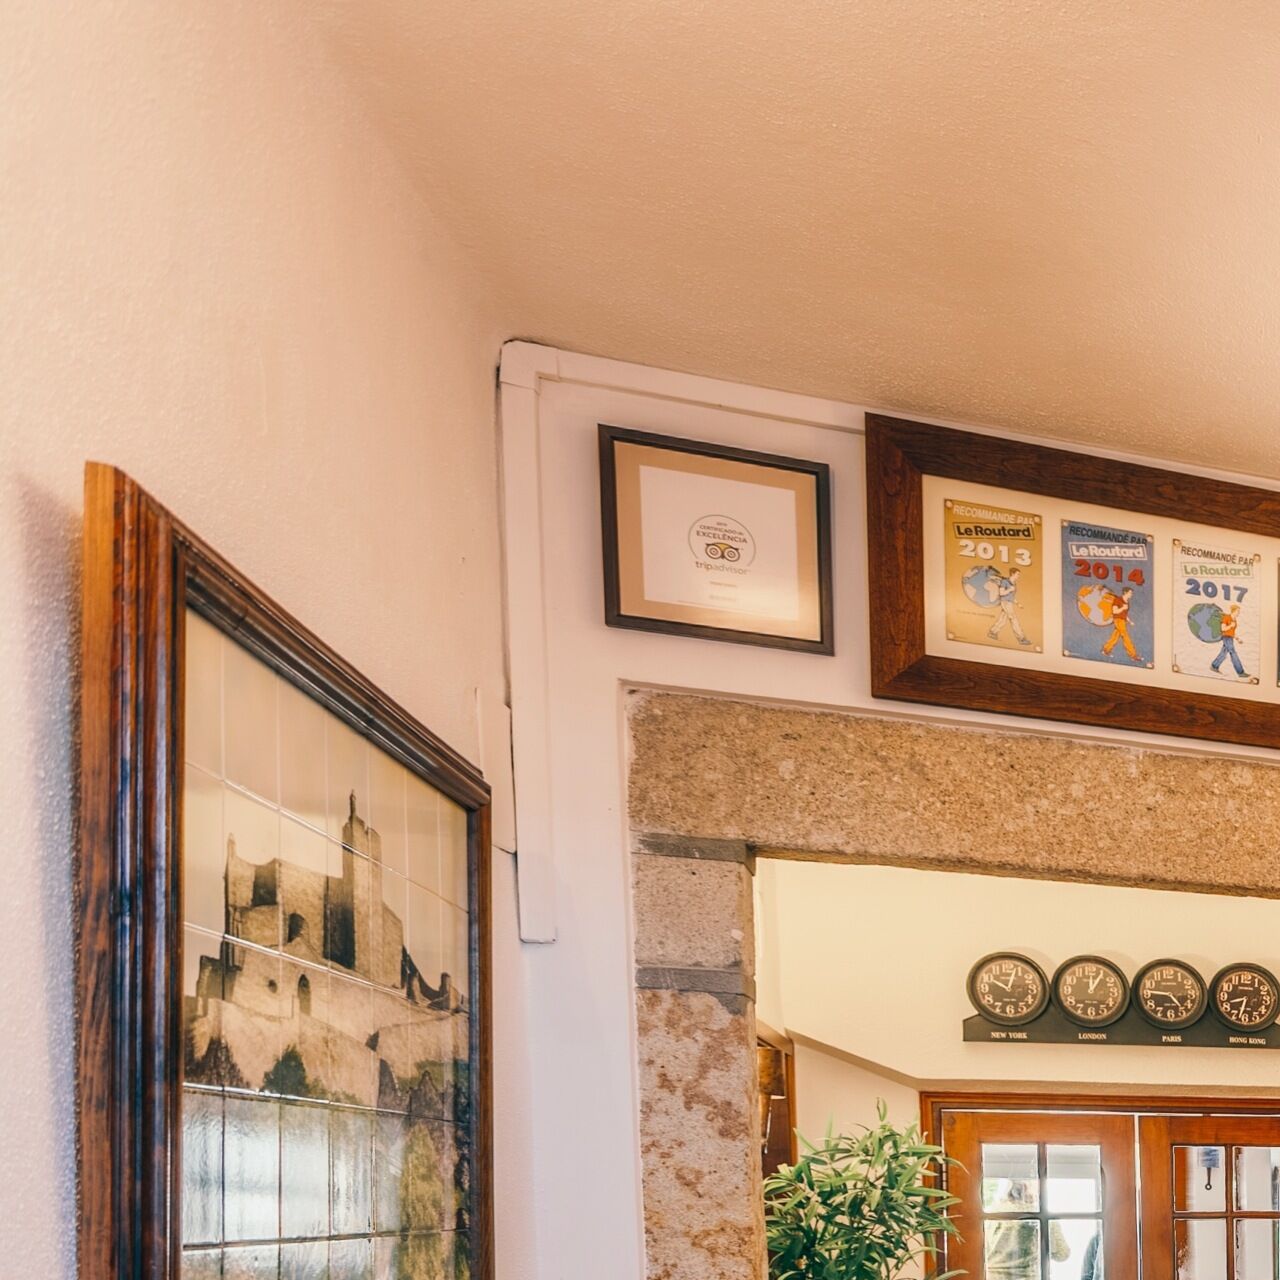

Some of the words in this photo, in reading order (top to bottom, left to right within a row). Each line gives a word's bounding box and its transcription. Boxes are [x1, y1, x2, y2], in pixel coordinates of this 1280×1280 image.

[956, 525, 974, 536] Le
[974, 525, 1031, 538] Routard
[1130, 534, 1148, 546] PAR
[959, 540, 1032, 566] 2013
[1072, 544, 1087, 556] Le
[1088, 545, 1145, 558] Routard
[1181, 546, 1237, 564] RECOMMANDÉ
[1238, 557, 1254, 567] PAR
[1074, 559, 1145, 586] 2014
[1184, 564, 1199, 575] Le
[1199, 565, 1250, 577] Routard
[1185, 578, 1248, 603] 2017
[992, 965, 1000, 974] 11
[1017, 967, 1022, 976] 1
[1163, 969, 1174, 978] 12
[983, 974, 993, 982] 10
[1024, 974, 1033, 983] 2
[1154, 972, 1161, 981] 11
[1177, 973, 1182, 981] 1
[981, 984, 989, 993] 9
[1144, 979, 1155, 989] 10
[1184, 979, 1192, 989] 2
[1028, 984, 1036, 994] 3
[1187, 989, 1195, 999] 3
[985, 995, 993, 1004] 8
[1025, 995, 1034, 1004] 4
[1184, 999, 1193, 1009] 4
[994, 1002, 1002, 1012] 7
[1018, 1003, 1026, 1013] 5
[1147, 1000, 1155, 1009] 8
[1006, 1005, 1014, 1014] 6
[1156, 1007, 1163, 1016] 7
[1167, 1010, 1175, 1019] 6
[1078, 1032, 1107, 1040] LONDON
[1161, 1035, 1182, 1043] PARIS
[1229, 1036, 1248, 1044] HONG
[1248, 1037, 1266, 1045] KONG
